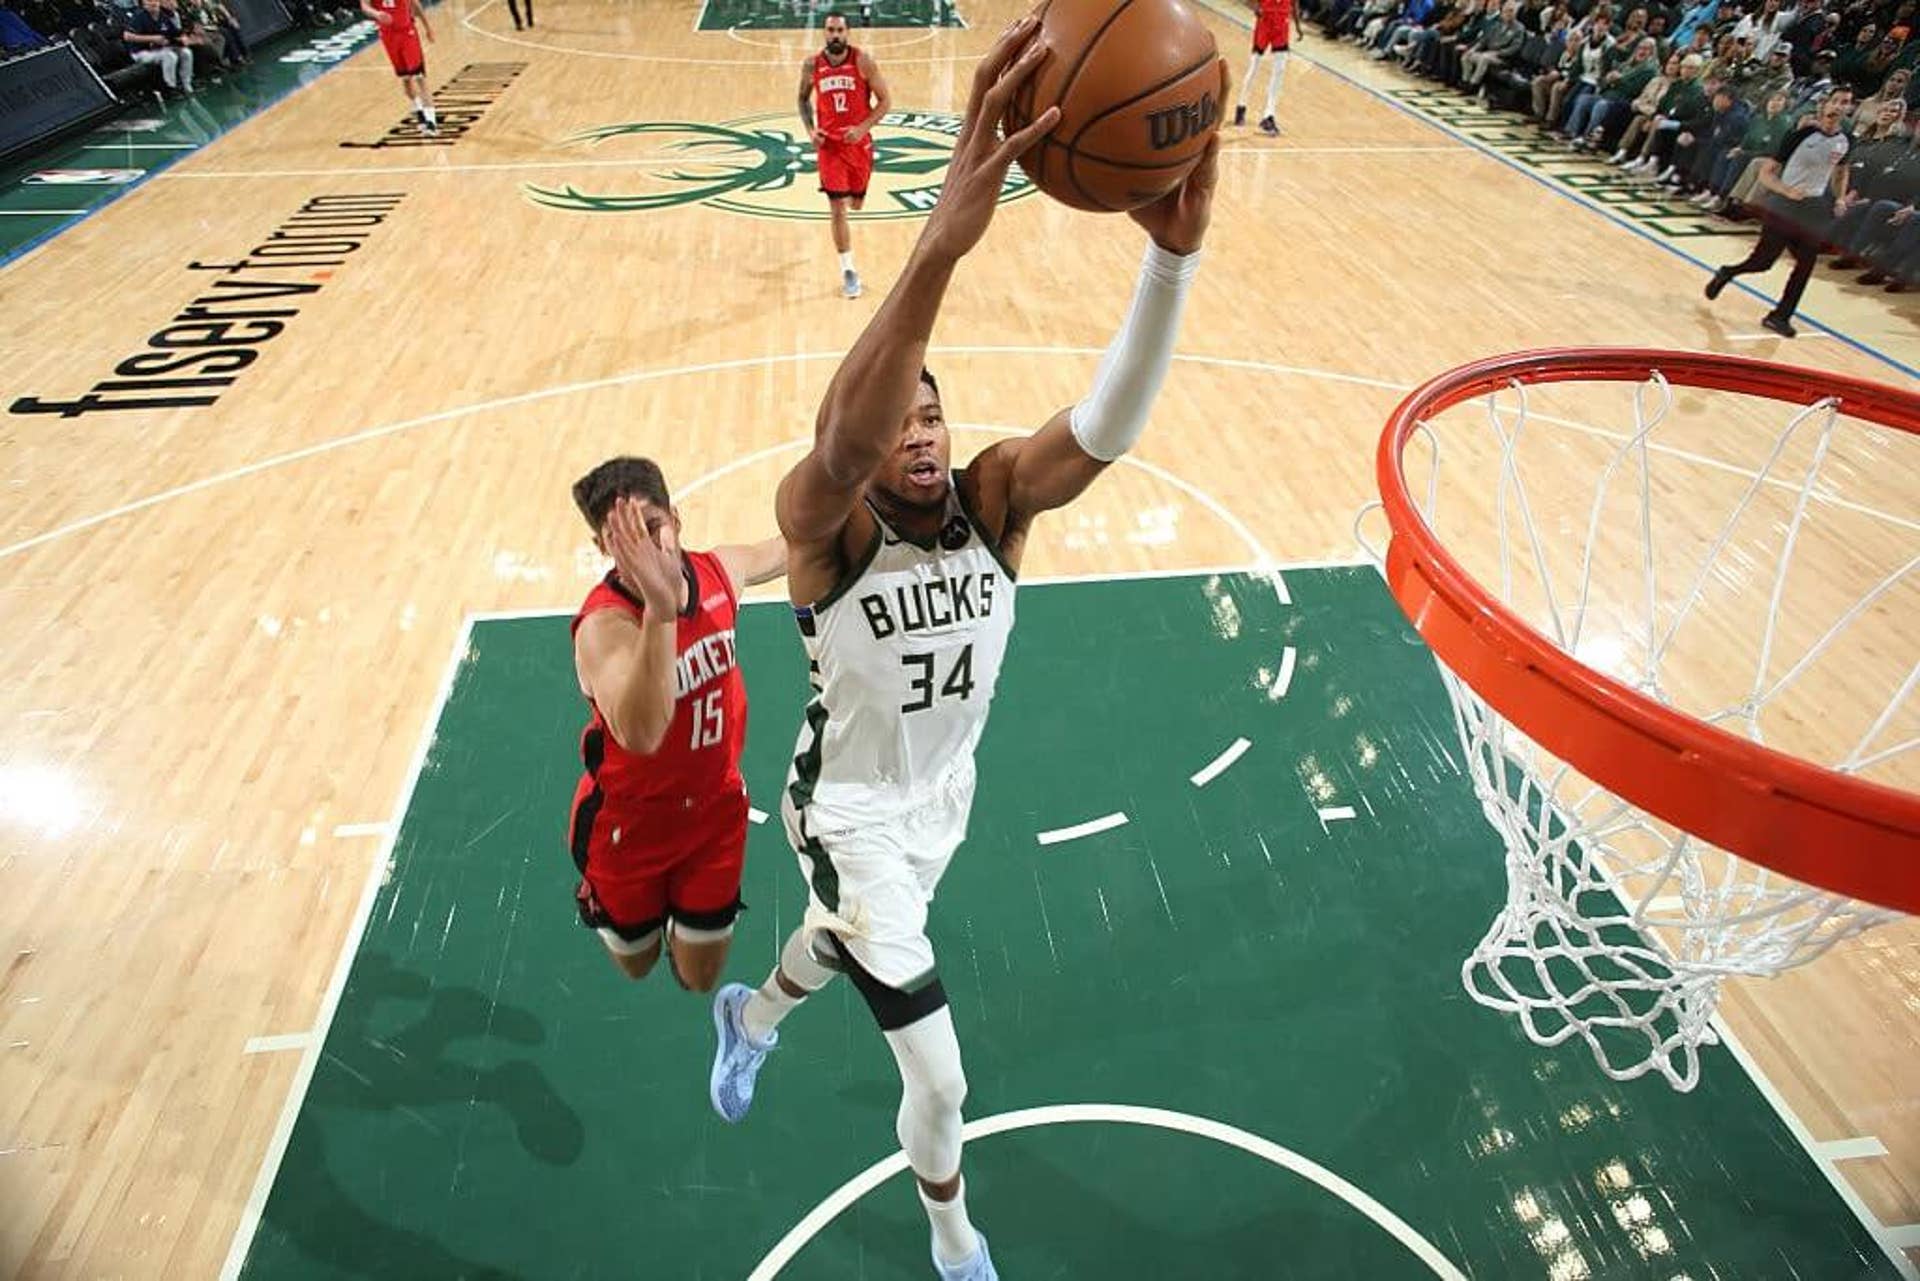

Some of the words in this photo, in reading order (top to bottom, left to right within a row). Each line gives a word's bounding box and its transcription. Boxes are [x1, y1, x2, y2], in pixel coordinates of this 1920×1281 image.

[832, 92, 849, 113] 12
[187, 193, 407, 273] forum
[860, 573, 995, 640] BUCKS
[901, 643, 975, 714] 34
[691, 688, 723, 751] 15
